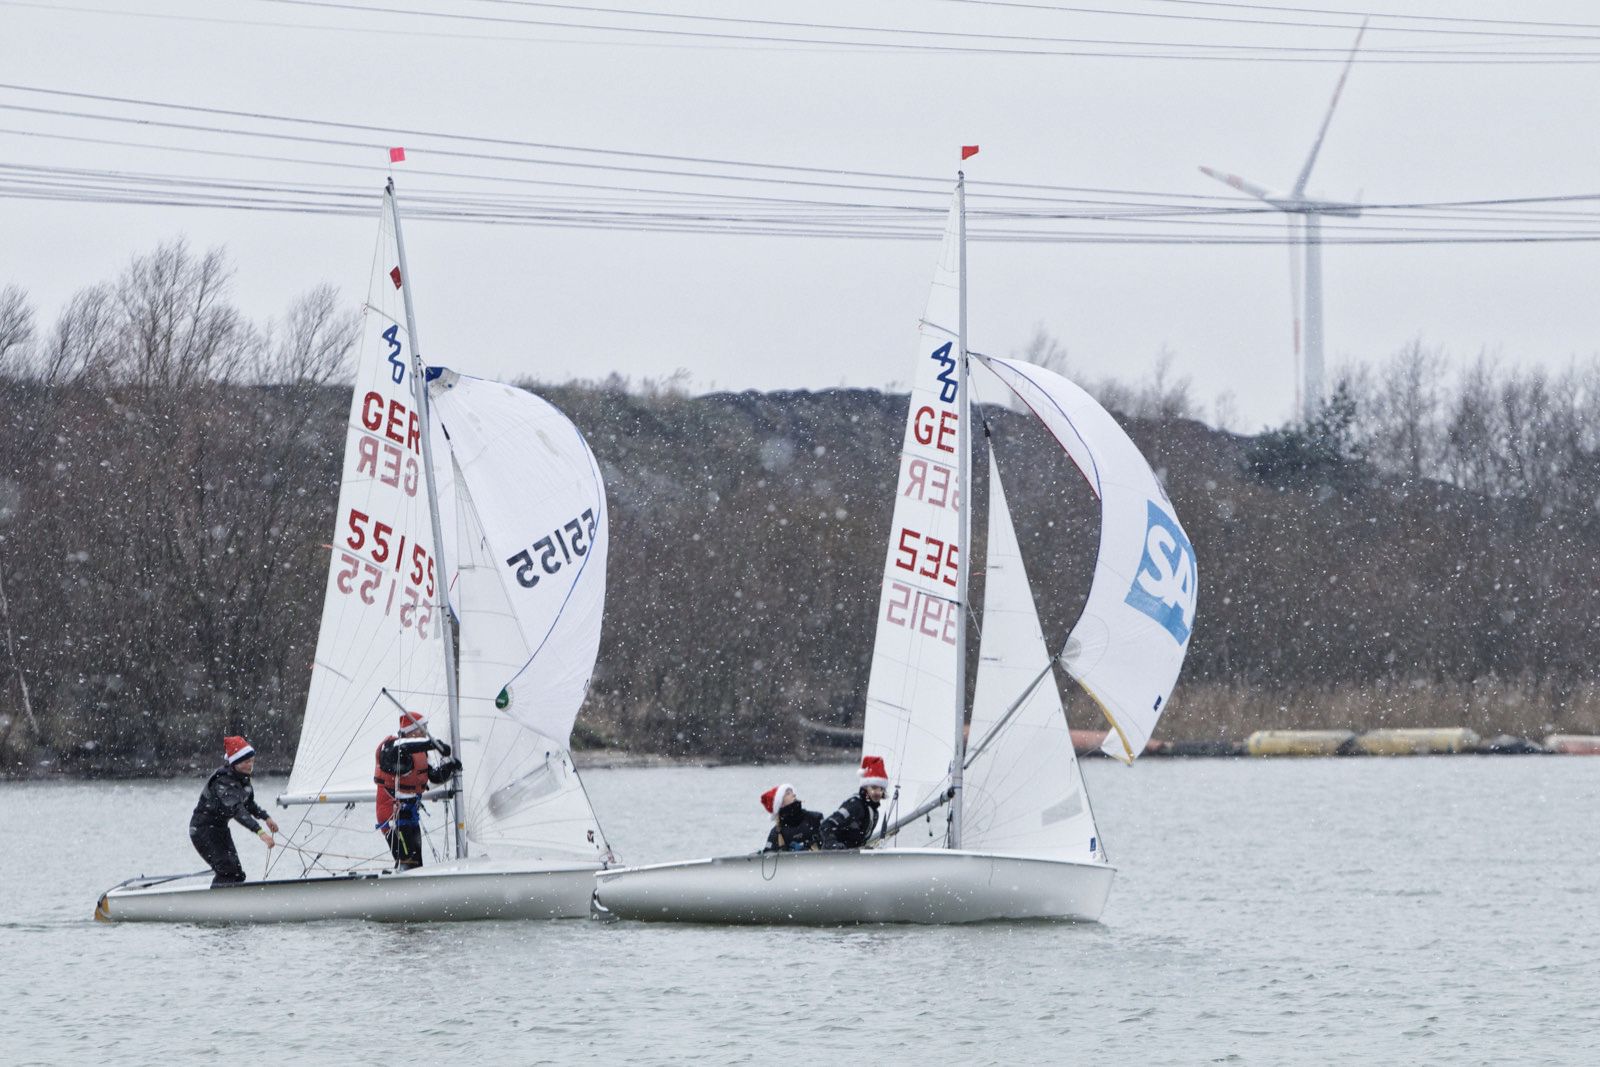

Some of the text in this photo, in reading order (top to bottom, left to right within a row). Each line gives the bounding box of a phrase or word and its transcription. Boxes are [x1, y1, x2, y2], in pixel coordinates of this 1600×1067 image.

[382, 324, 405, 385] 420
[931, 341, 959, 404] 420
[361, 391, 421, 456] GER
[914, 405, 958, 453] GE
